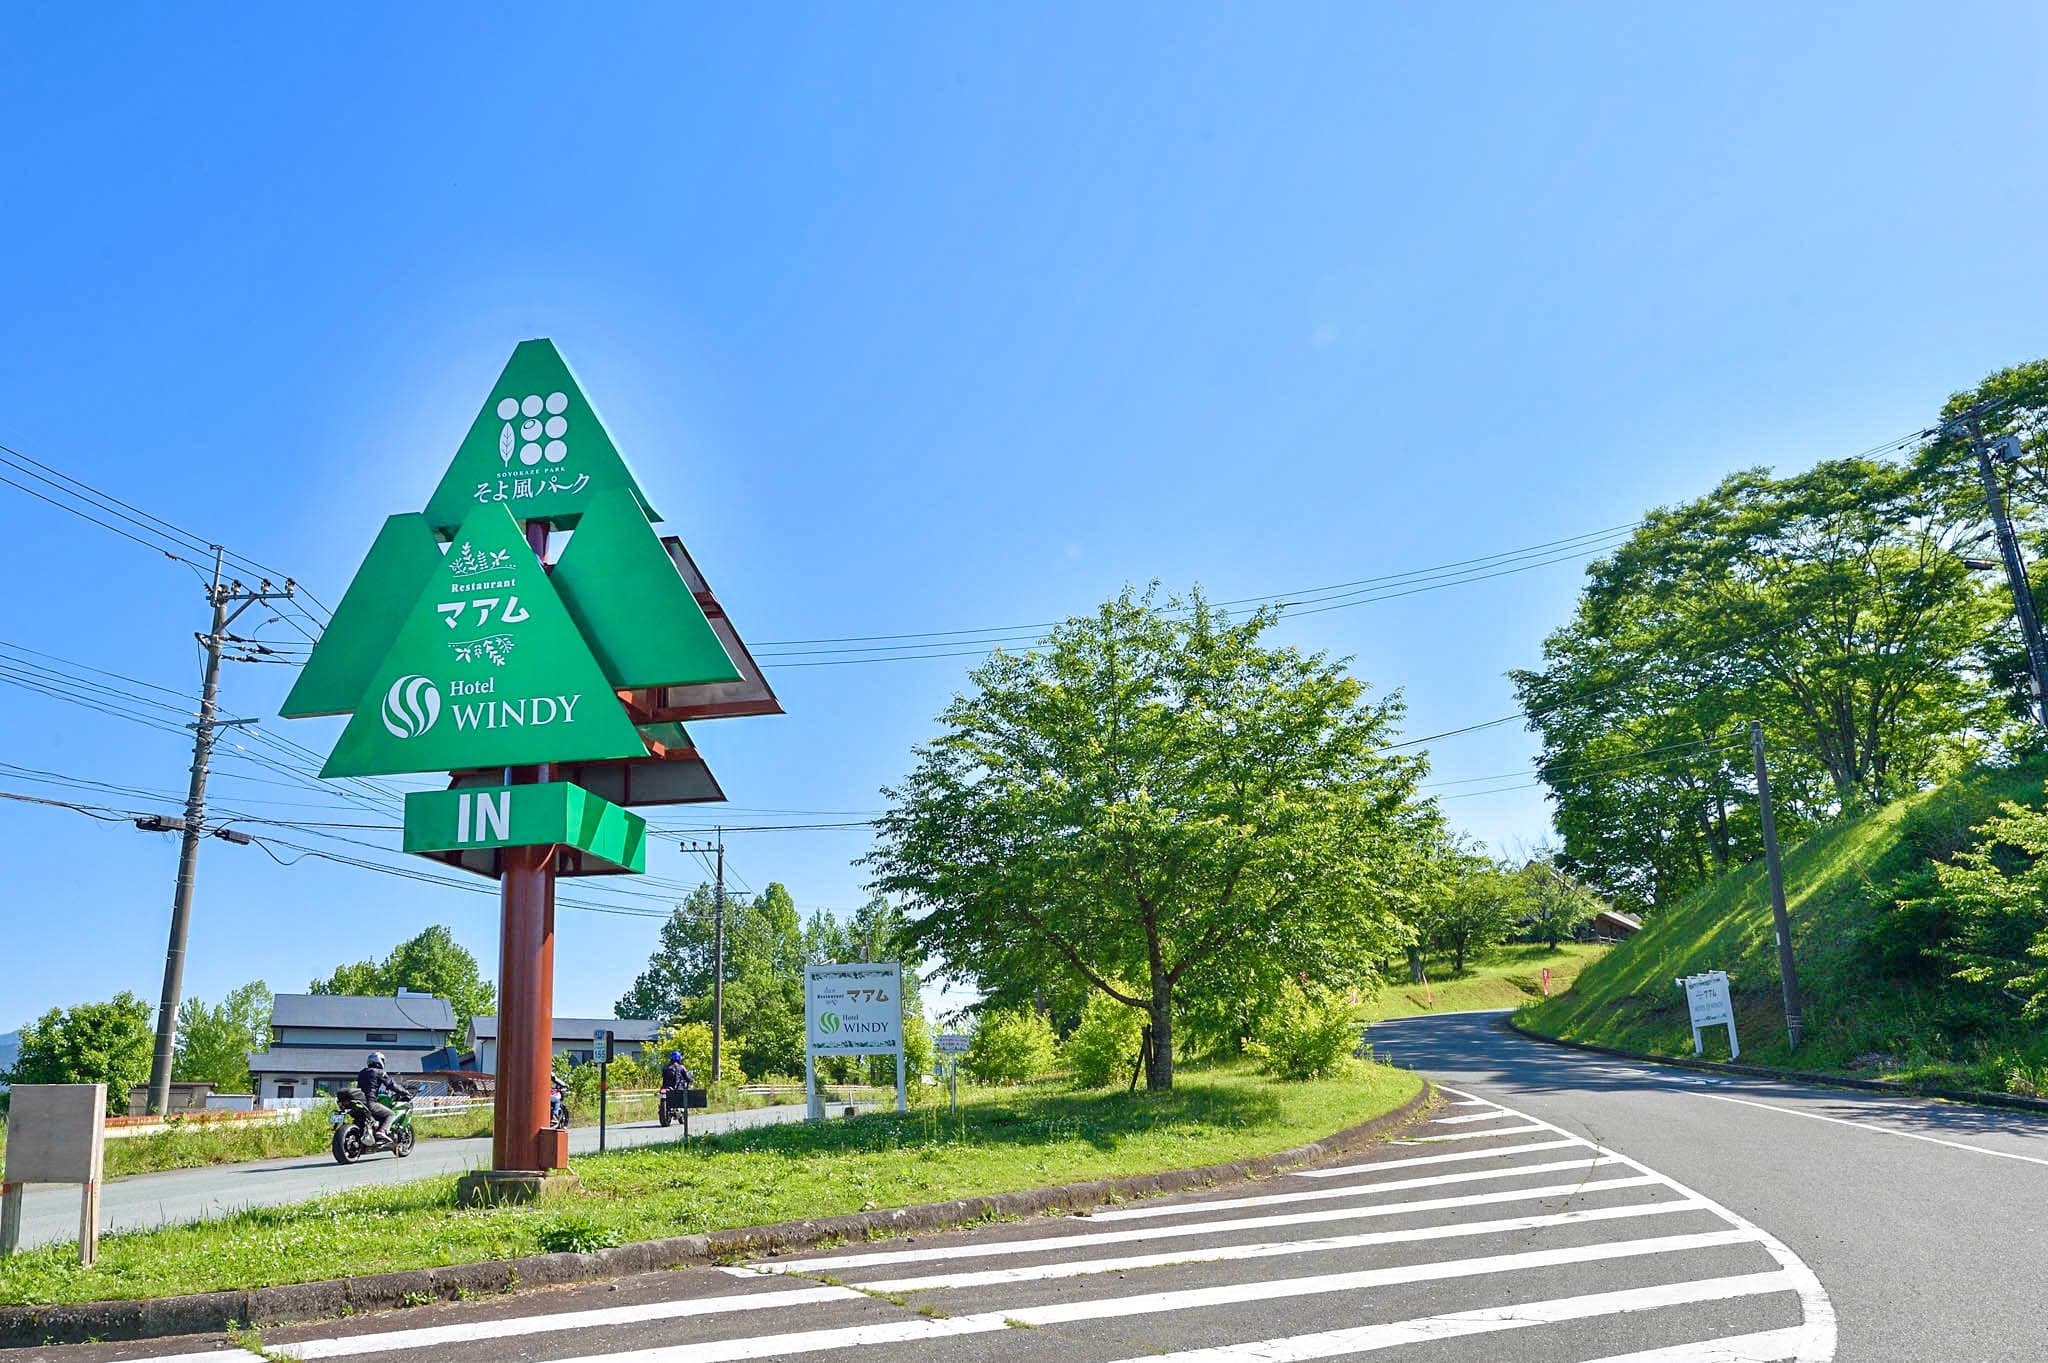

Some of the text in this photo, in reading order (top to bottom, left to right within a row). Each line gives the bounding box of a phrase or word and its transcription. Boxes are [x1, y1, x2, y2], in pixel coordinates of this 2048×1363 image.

[496, 466, 566, 479] SOYOKAZE PARK
[473, 473, 592, 504] そよ風パーク
[450, 578, 517, 593] Restaurant
[437, 596, 530, 629] マアム
[449, 677, 495, 697] Hotel
[450, 694, 582, 732] WINDY
[457, 791, 511, 843] IN
[847, 988, 889, 1004] マアム
[842, 1014, 859, 1022] Hotel
[843, 1022, 889, 1033] WINDY
